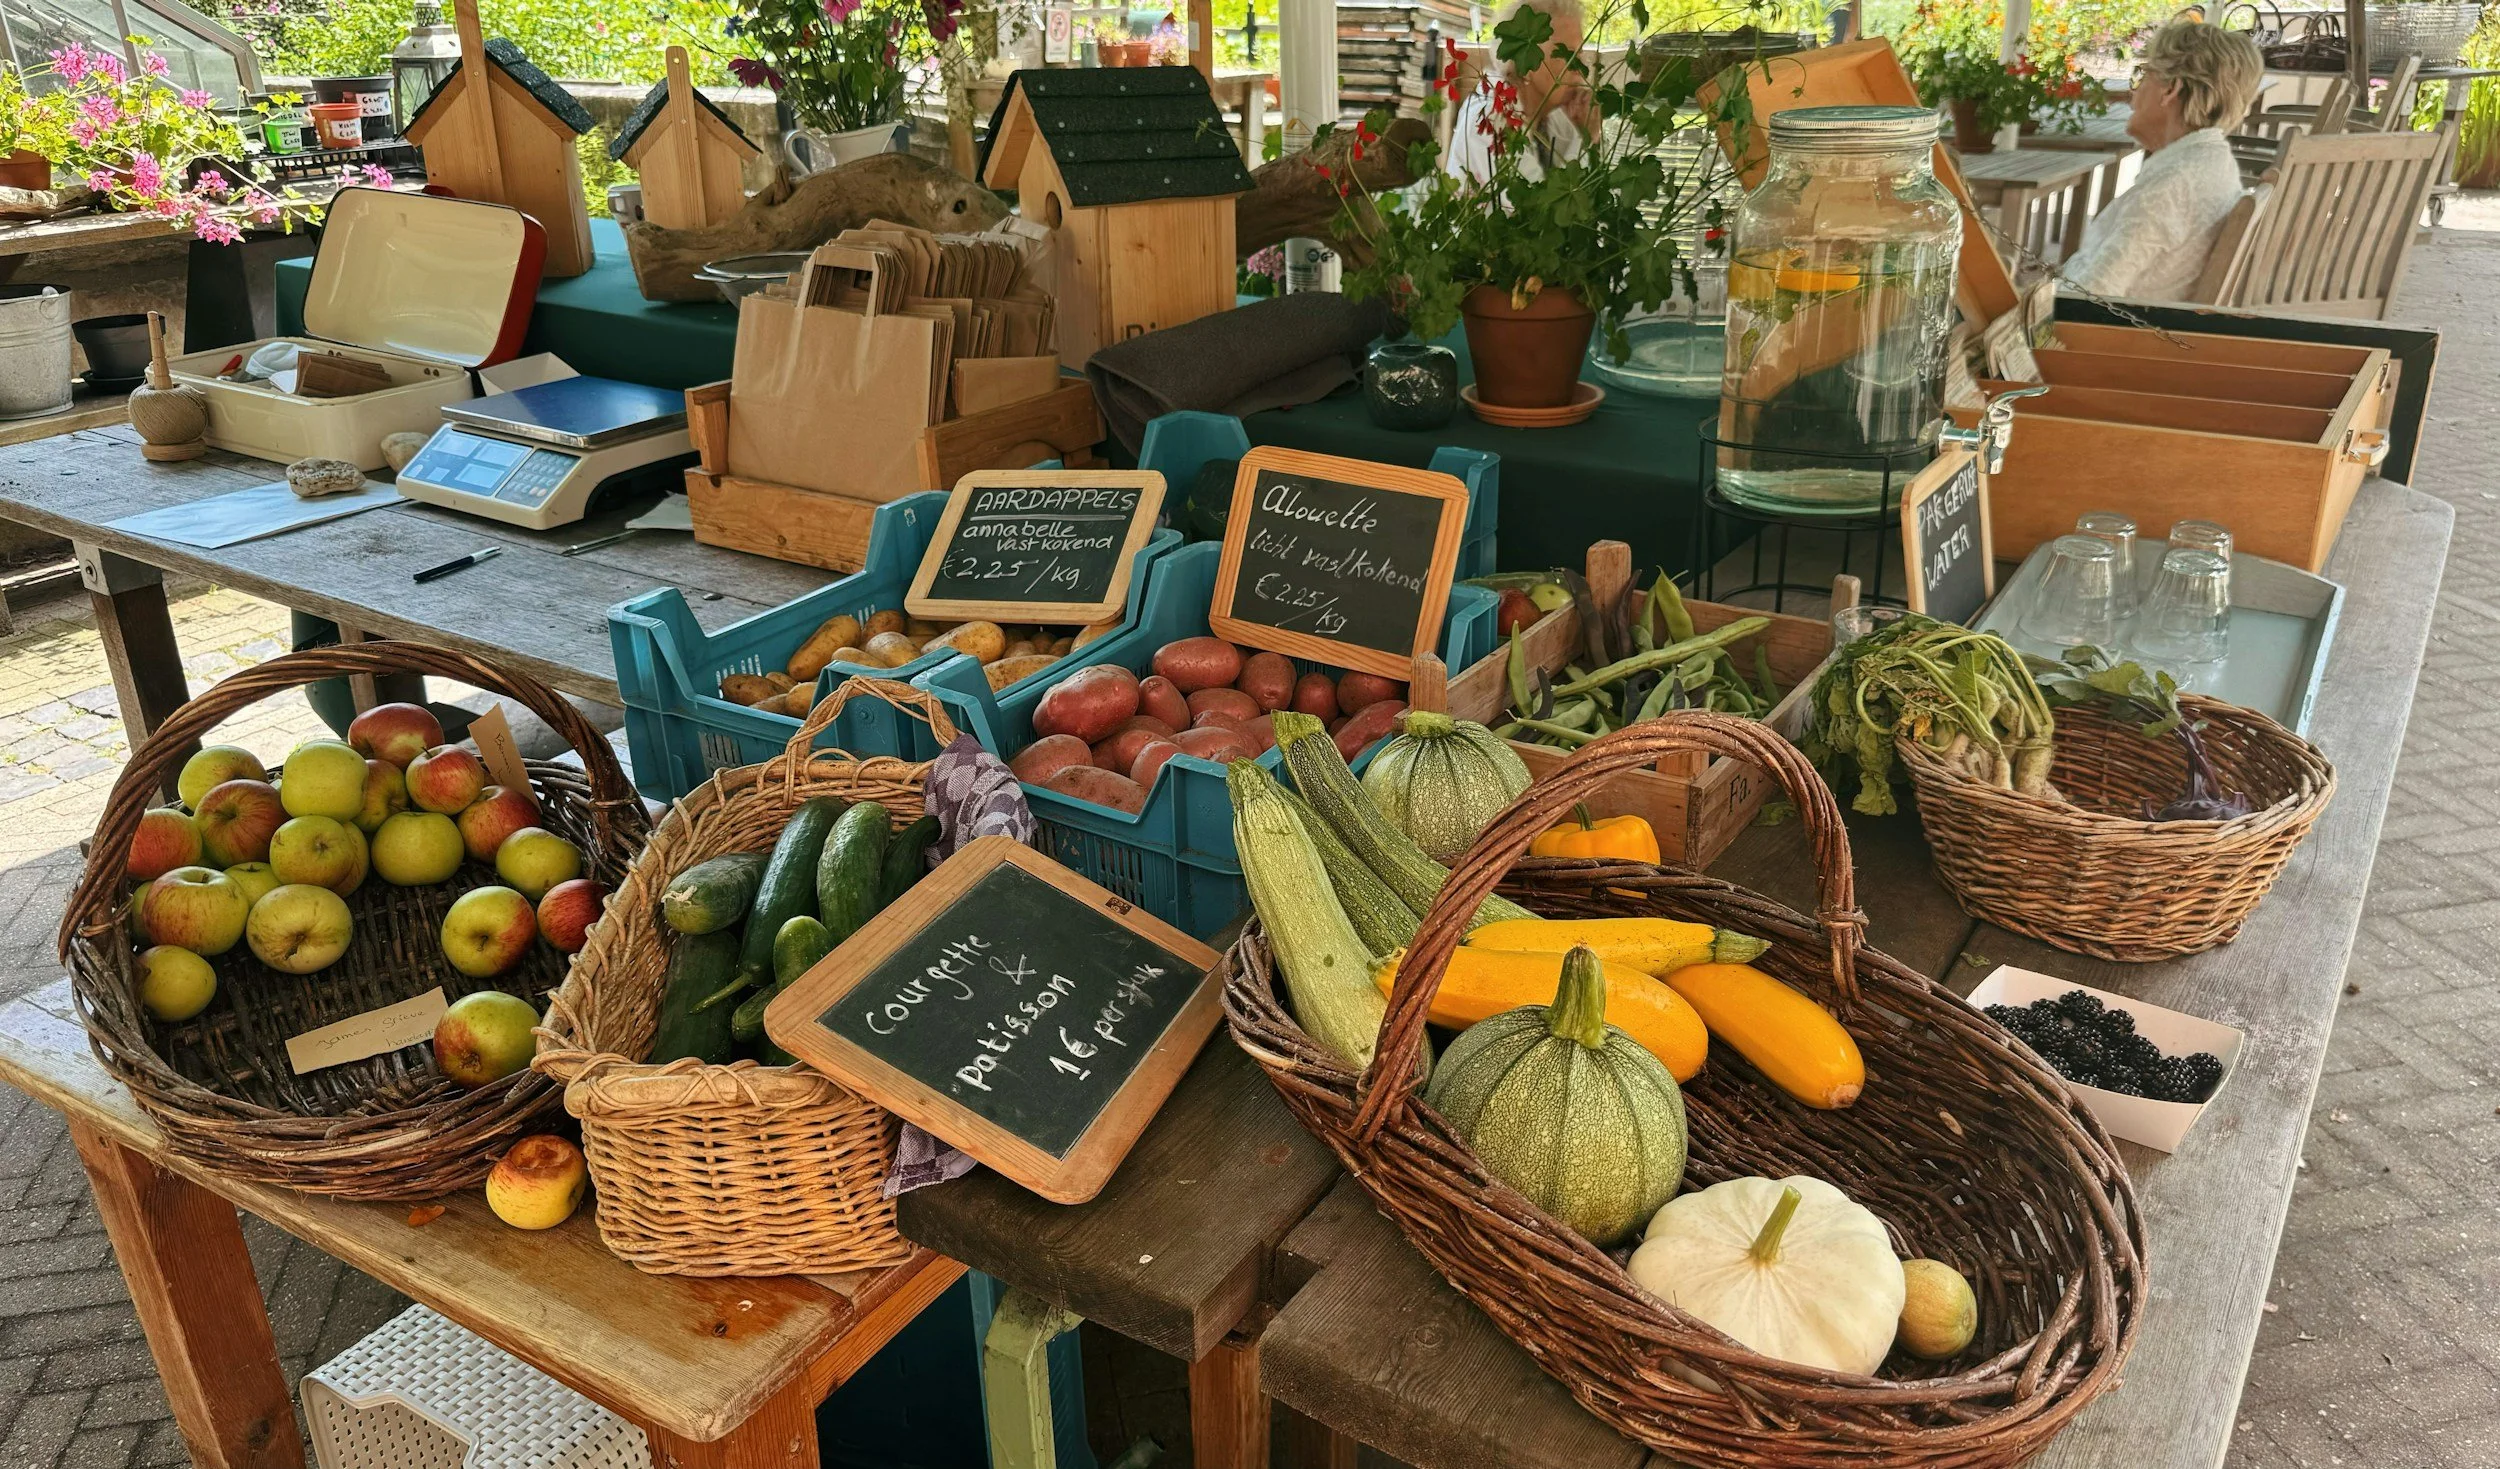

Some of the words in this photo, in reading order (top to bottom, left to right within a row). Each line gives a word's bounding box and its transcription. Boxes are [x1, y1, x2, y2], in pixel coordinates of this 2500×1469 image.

[974, 488, 1138, 513] AARDAPPELS
[1262, 484, 1379, 534] Alouette
[962, 520, 1078, 539] annabelle
[1924, 523, 1971, 593] WATER
[865, 934, 993, 1035] Courgette
[988, 953, 1038, 986] &
[955, 973, 1077, 1092] patisson
[1093, 999, 1128, 1047] per
